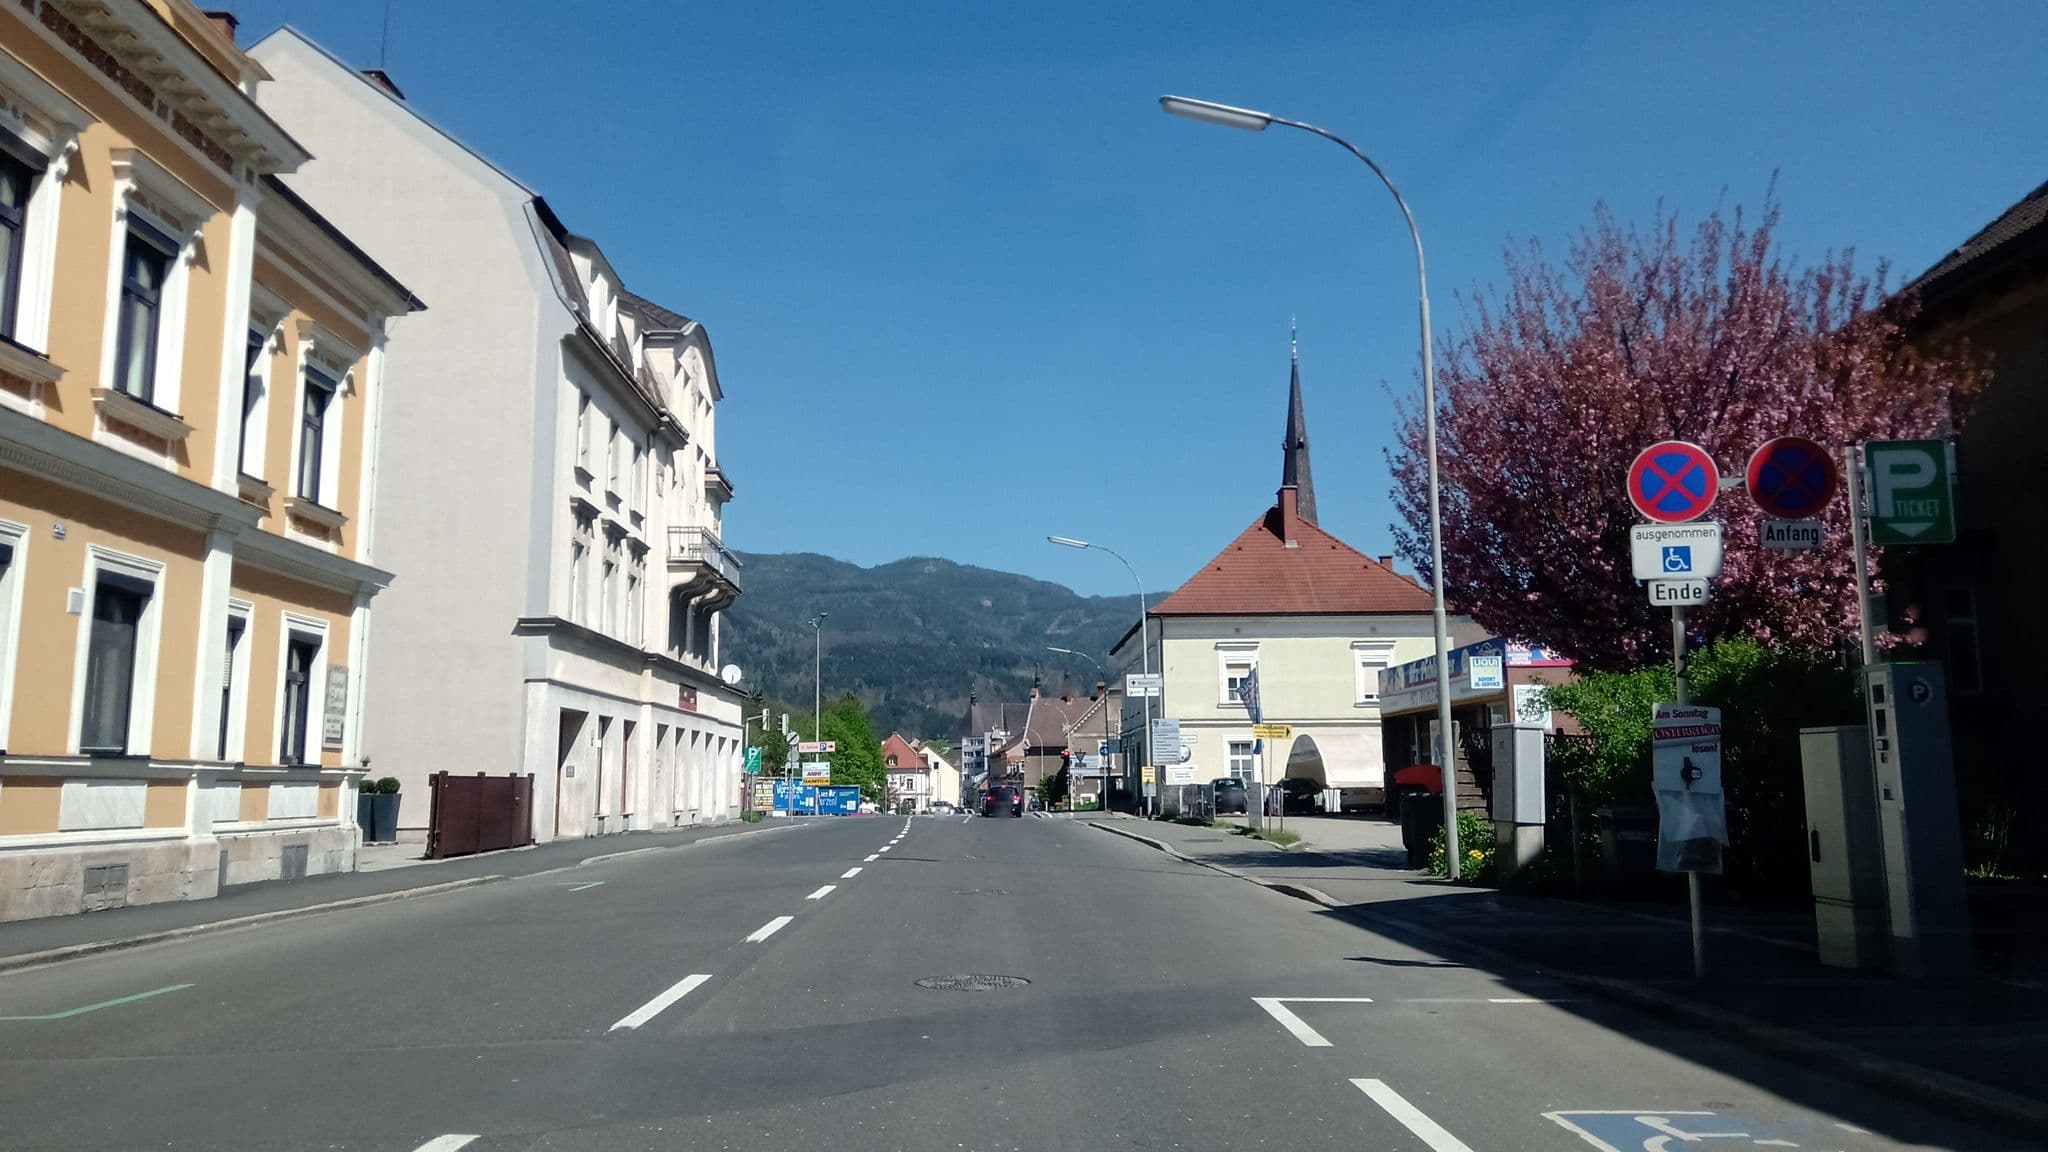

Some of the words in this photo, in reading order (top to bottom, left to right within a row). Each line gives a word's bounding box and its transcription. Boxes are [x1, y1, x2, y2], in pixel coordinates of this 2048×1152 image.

[1874, 450, 1937, 517] P
[1895, 499, 1940, 517] TICKET
[1635, 527, 1717, 542] ausgenommen
[1765, 524, 1819, 547] Anfang
[1655, 584, 1703, 601] Ende
[1656, 710, 1670, 719] Am
[1672, 709, 1708, 720] Sonntag
